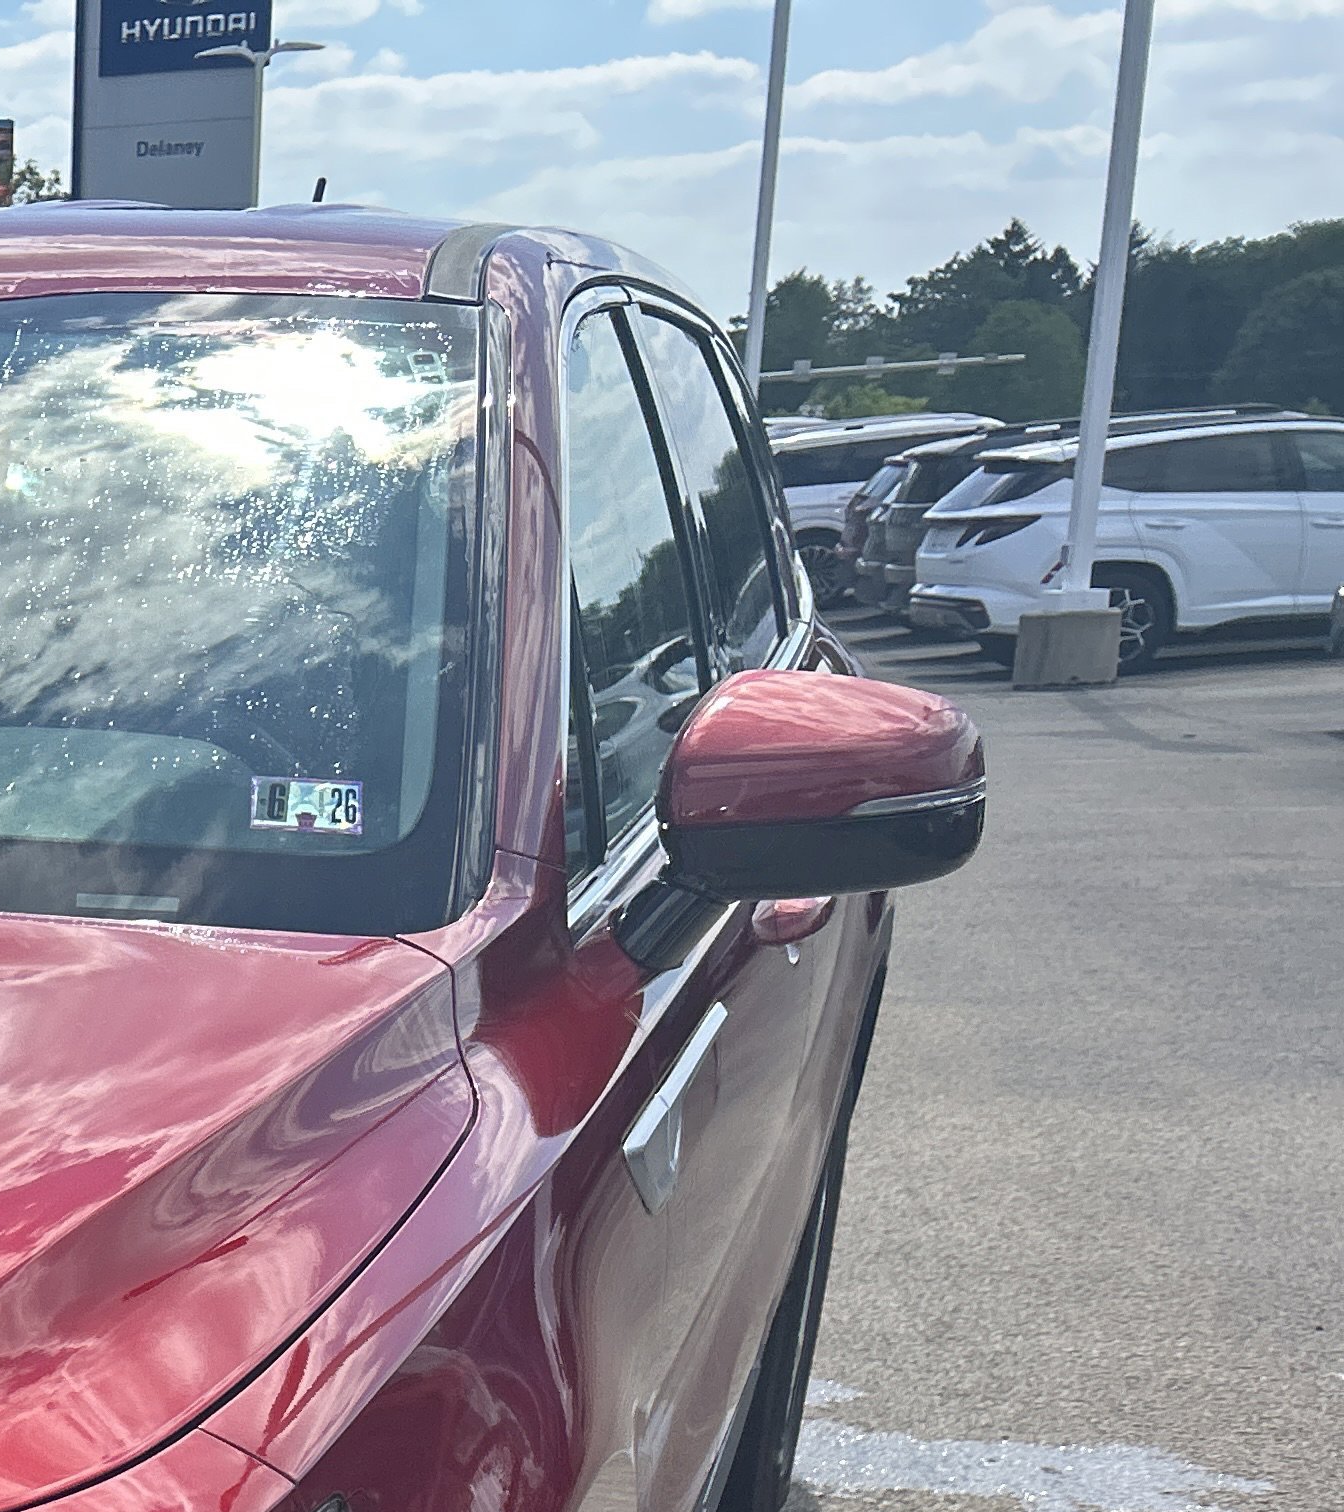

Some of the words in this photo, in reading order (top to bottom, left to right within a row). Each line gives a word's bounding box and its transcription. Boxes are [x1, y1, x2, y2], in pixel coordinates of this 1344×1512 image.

[121, 11, 256, 43] HYUNDAI
[136, 140, 205, 158] Delaney
[331, 788, 357, 824] 26
